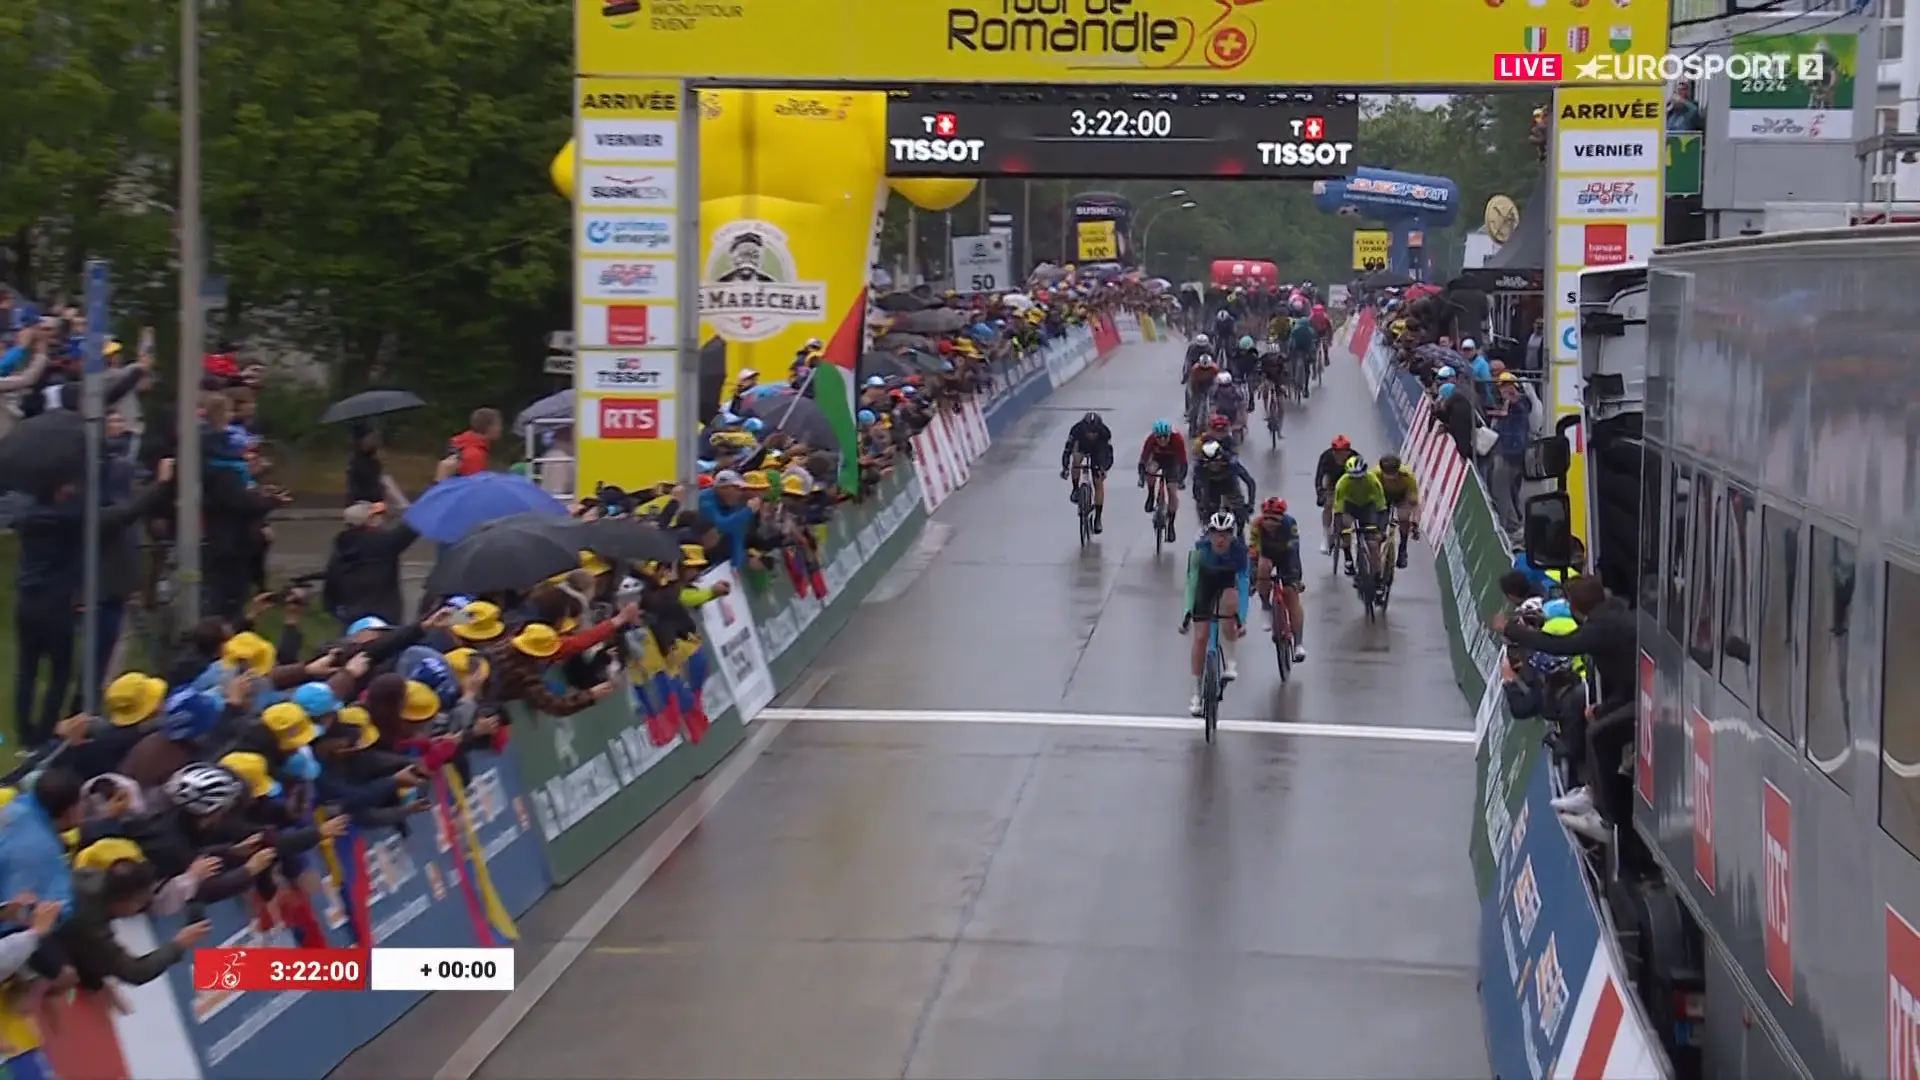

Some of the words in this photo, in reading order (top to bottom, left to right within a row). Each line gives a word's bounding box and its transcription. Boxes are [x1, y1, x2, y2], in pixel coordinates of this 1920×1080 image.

[948, 9, 1178, 51] Romandie
[1741, 79, 1787, 92] 2024
[582, 91, 677, 111] ARRIVÉE
[1561, 98, 1659, 119] ARRIVÉE
[1070, 110, 1171, 136] 3:22:00
[594, 134, 664, 147] VERNIER
[890, 138, 984, 162] TISSOT
[1574, 144, 1644, 158] VERNIER
[1257, 142, 1353, 165] TISSOT
[1583, 182, 1635, 193] JOUEZ
[971, 274, 995, 290] 50
[708, 286, 821, 310] MARÉCHAL
[604, 409, 655, 430] RTS
[1695, 752, 1711, 844] RTS
[1766, 830, 1789, 945] RTS
